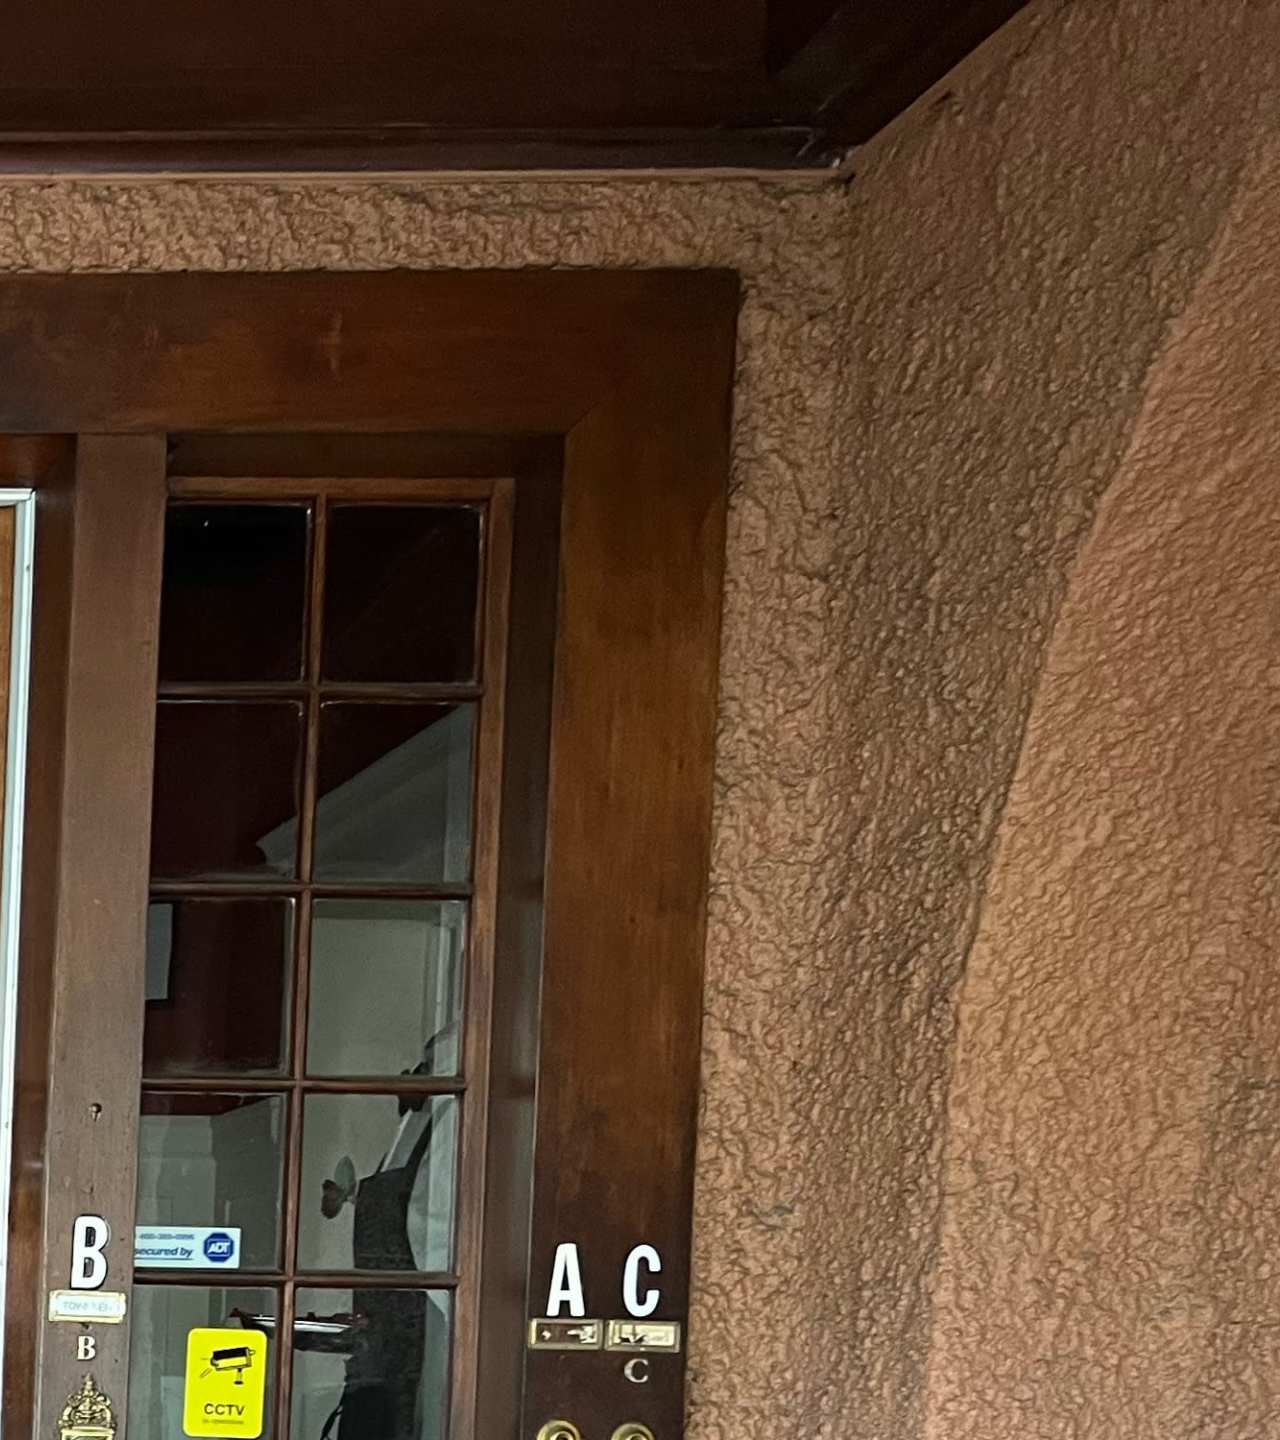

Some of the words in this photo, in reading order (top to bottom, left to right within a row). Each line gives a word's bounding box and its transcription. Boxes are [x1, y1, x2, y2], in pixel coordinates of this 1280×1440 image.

[70, 1214, 109, 1289] B
[179, 1247, 193, 1258] by
[207, 1241, 231, 1254] ADT
[546, 1242, 586, 1317] A
[622, 1244, 662, 1318] C
[77, 1335, 96, 1360] B
[624, 1358, 649, 1383] C
[203, 1402, 245, 1417] CCTV
